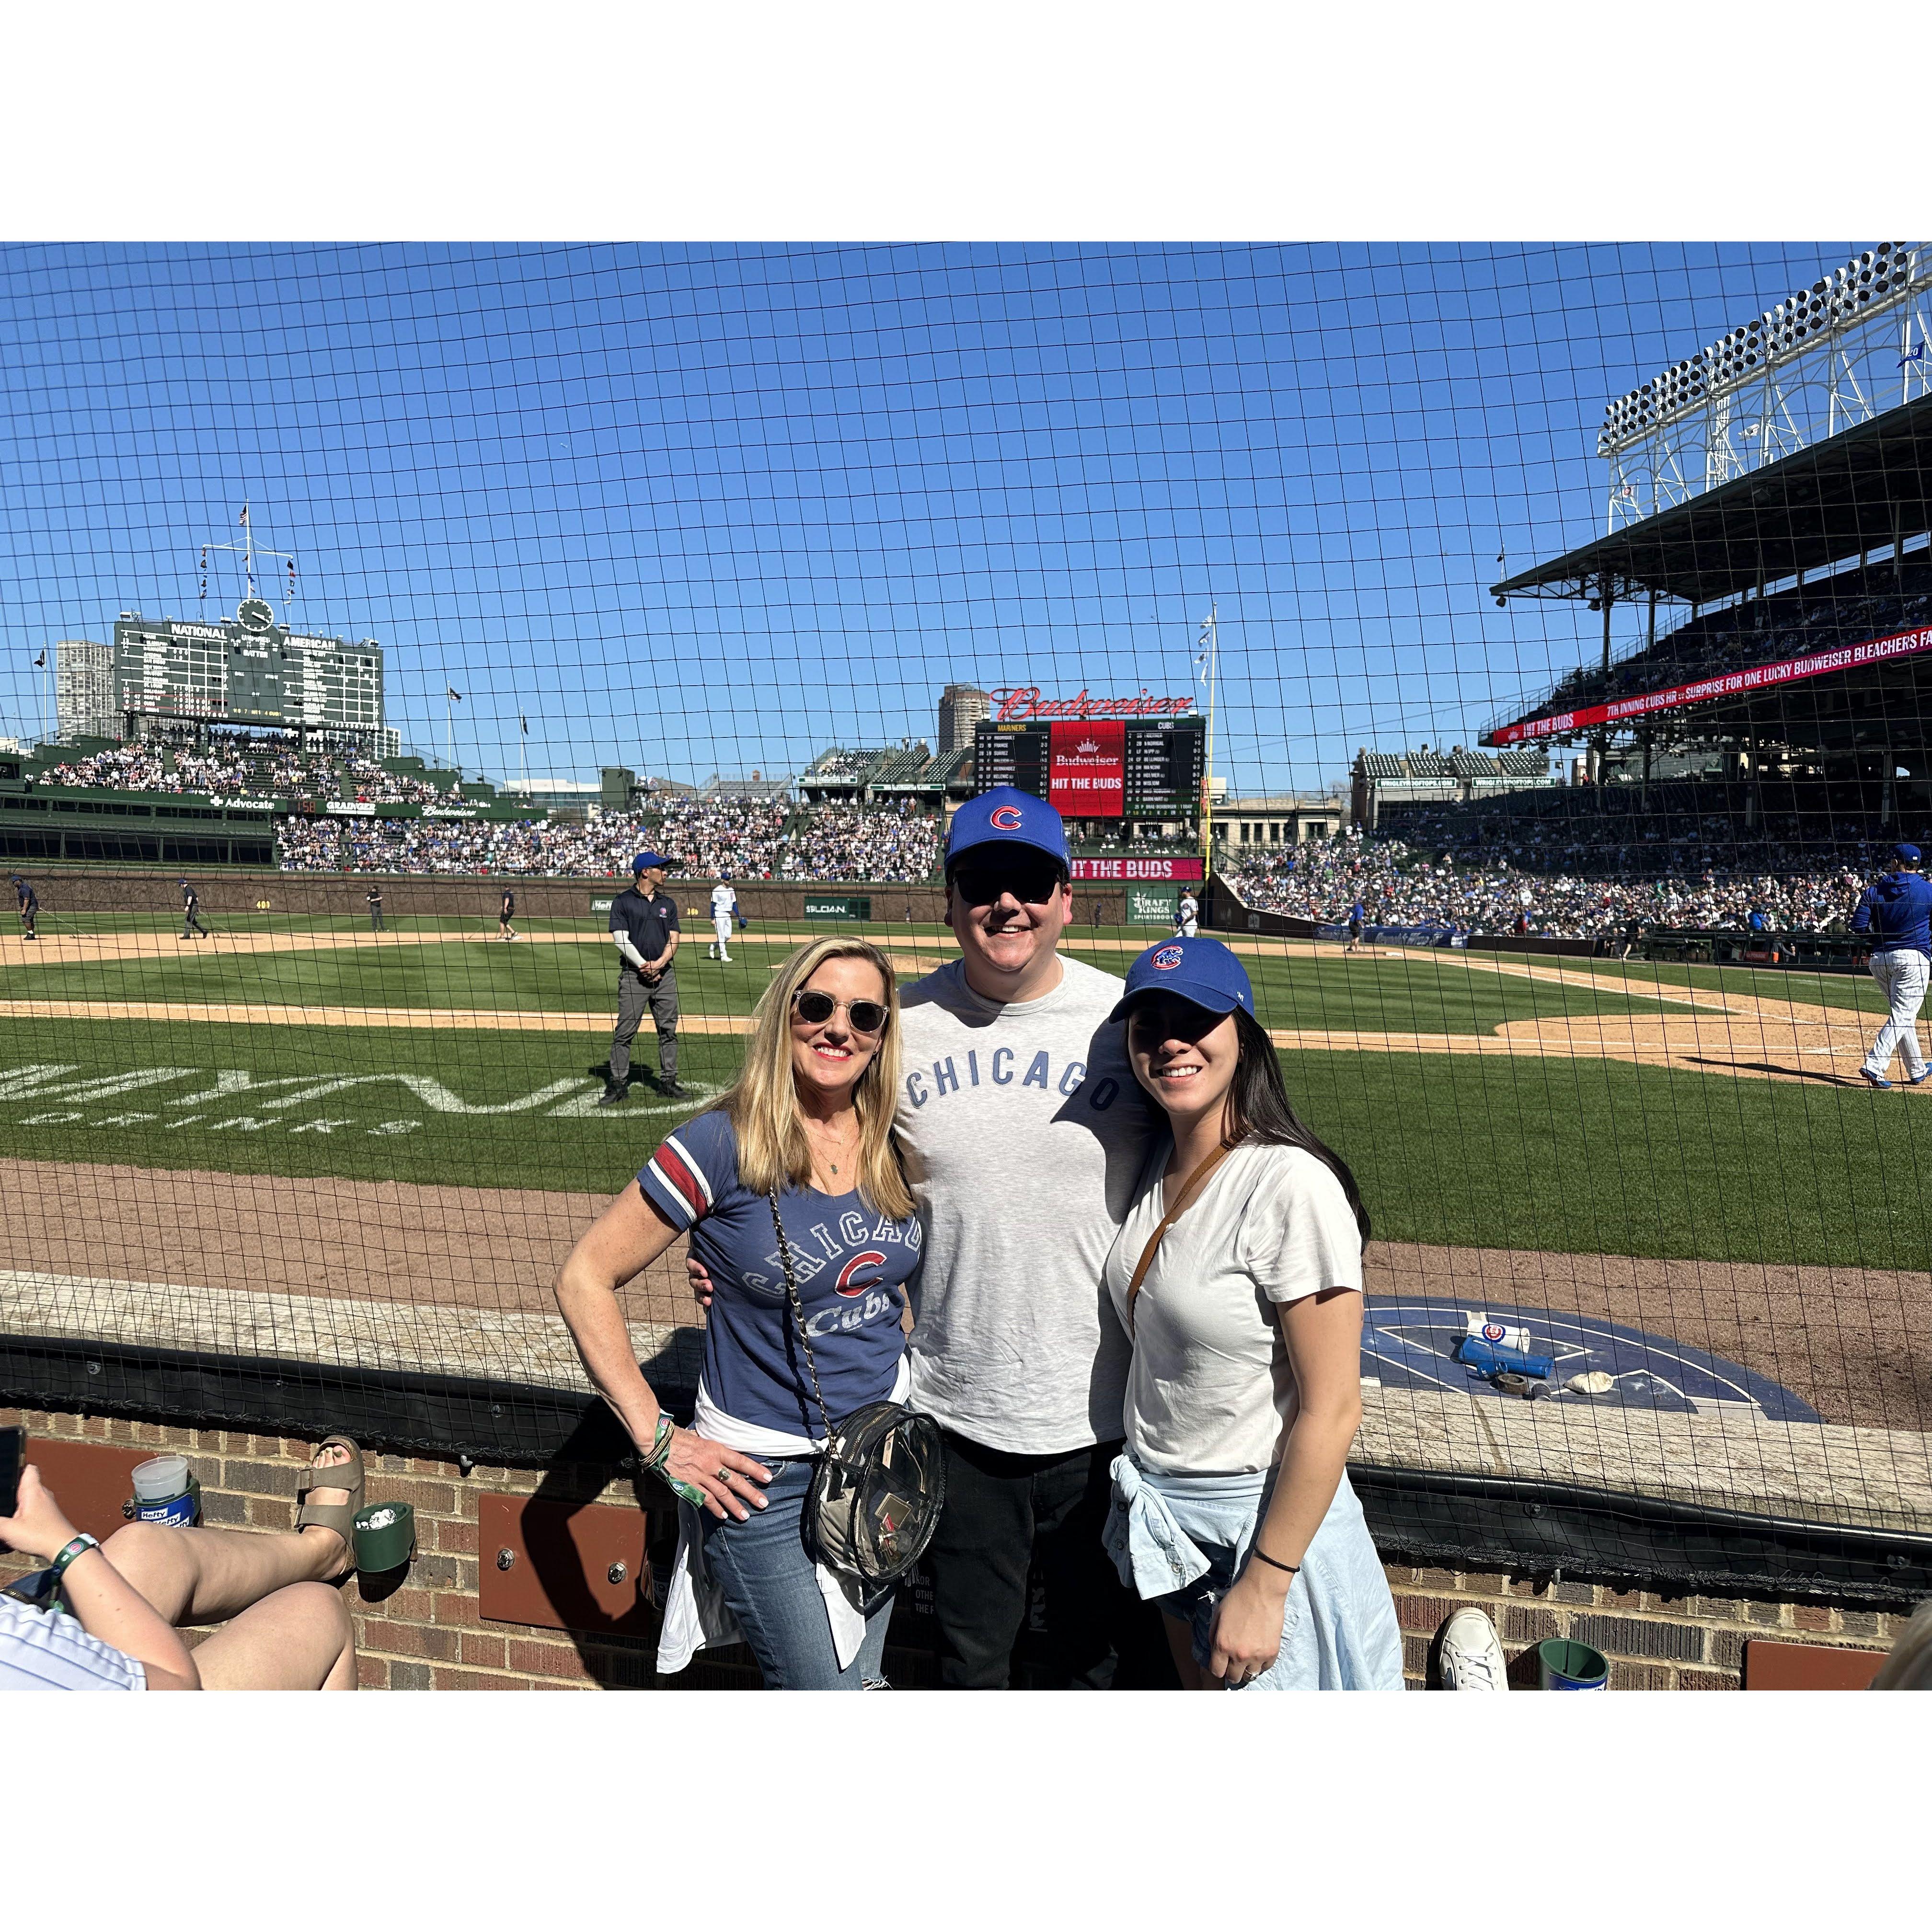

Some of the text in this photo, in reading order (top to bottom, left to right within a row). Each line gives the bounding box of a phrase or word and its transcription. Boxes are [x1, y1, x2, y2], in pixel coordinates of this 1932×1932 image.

[172, 624, 228, 639] NATIONAL
[283, 636, 335, 650] AMERICAN
[243, 649, 268, 658] BATTER
[1607, 704, 1619, 717] 7TH
[1620, 699, 1644, 714] INNING
[1645, 694, 1665, 709] CUBS
[1666, 690, 1677, 703] HR
[1685, 679, 1725, 700] SURPRISE
[1726, 676, 1742, 691] FOR
[1744, 670, 1762, 686] ONE
[1763, 663, 1793, 682] LUCKY
[1794, 650, 1852, 675] BUDWEISER
[1854, 634, 1917, 661] BLEACHERS
[990, 687, 1194, 721] Budweiser
[1523, 713, 1574, 737] HIT THE BUDS
[1056, 755, 1119, 766] Budweiser
[1052, 778, 1121, 789] HIT THE BUDS
[225, 798, 275, 809] Advocate
[326, 801, 376, 811] GRAINGER
[421, 805, 477, 816] Budweiser
[990, 805, 1022, 830] C
[1090, 861, 1122, 877] THE
[1127, 860, 1173, 877] BUDS
[256, 901, 270, 909] 400
[806, 905, 845, 913] SLOAN
[1134, 899, 1172, 908] DRAFT
[906, 1047, 1119, 1111] CHICAGO
[18, 1112, 424, 1135] DRINKS
[834, 1250, 887, 1298] C
[157, 1516, 179, 1525] efty
[915, 1603, 929, 1614] THE
